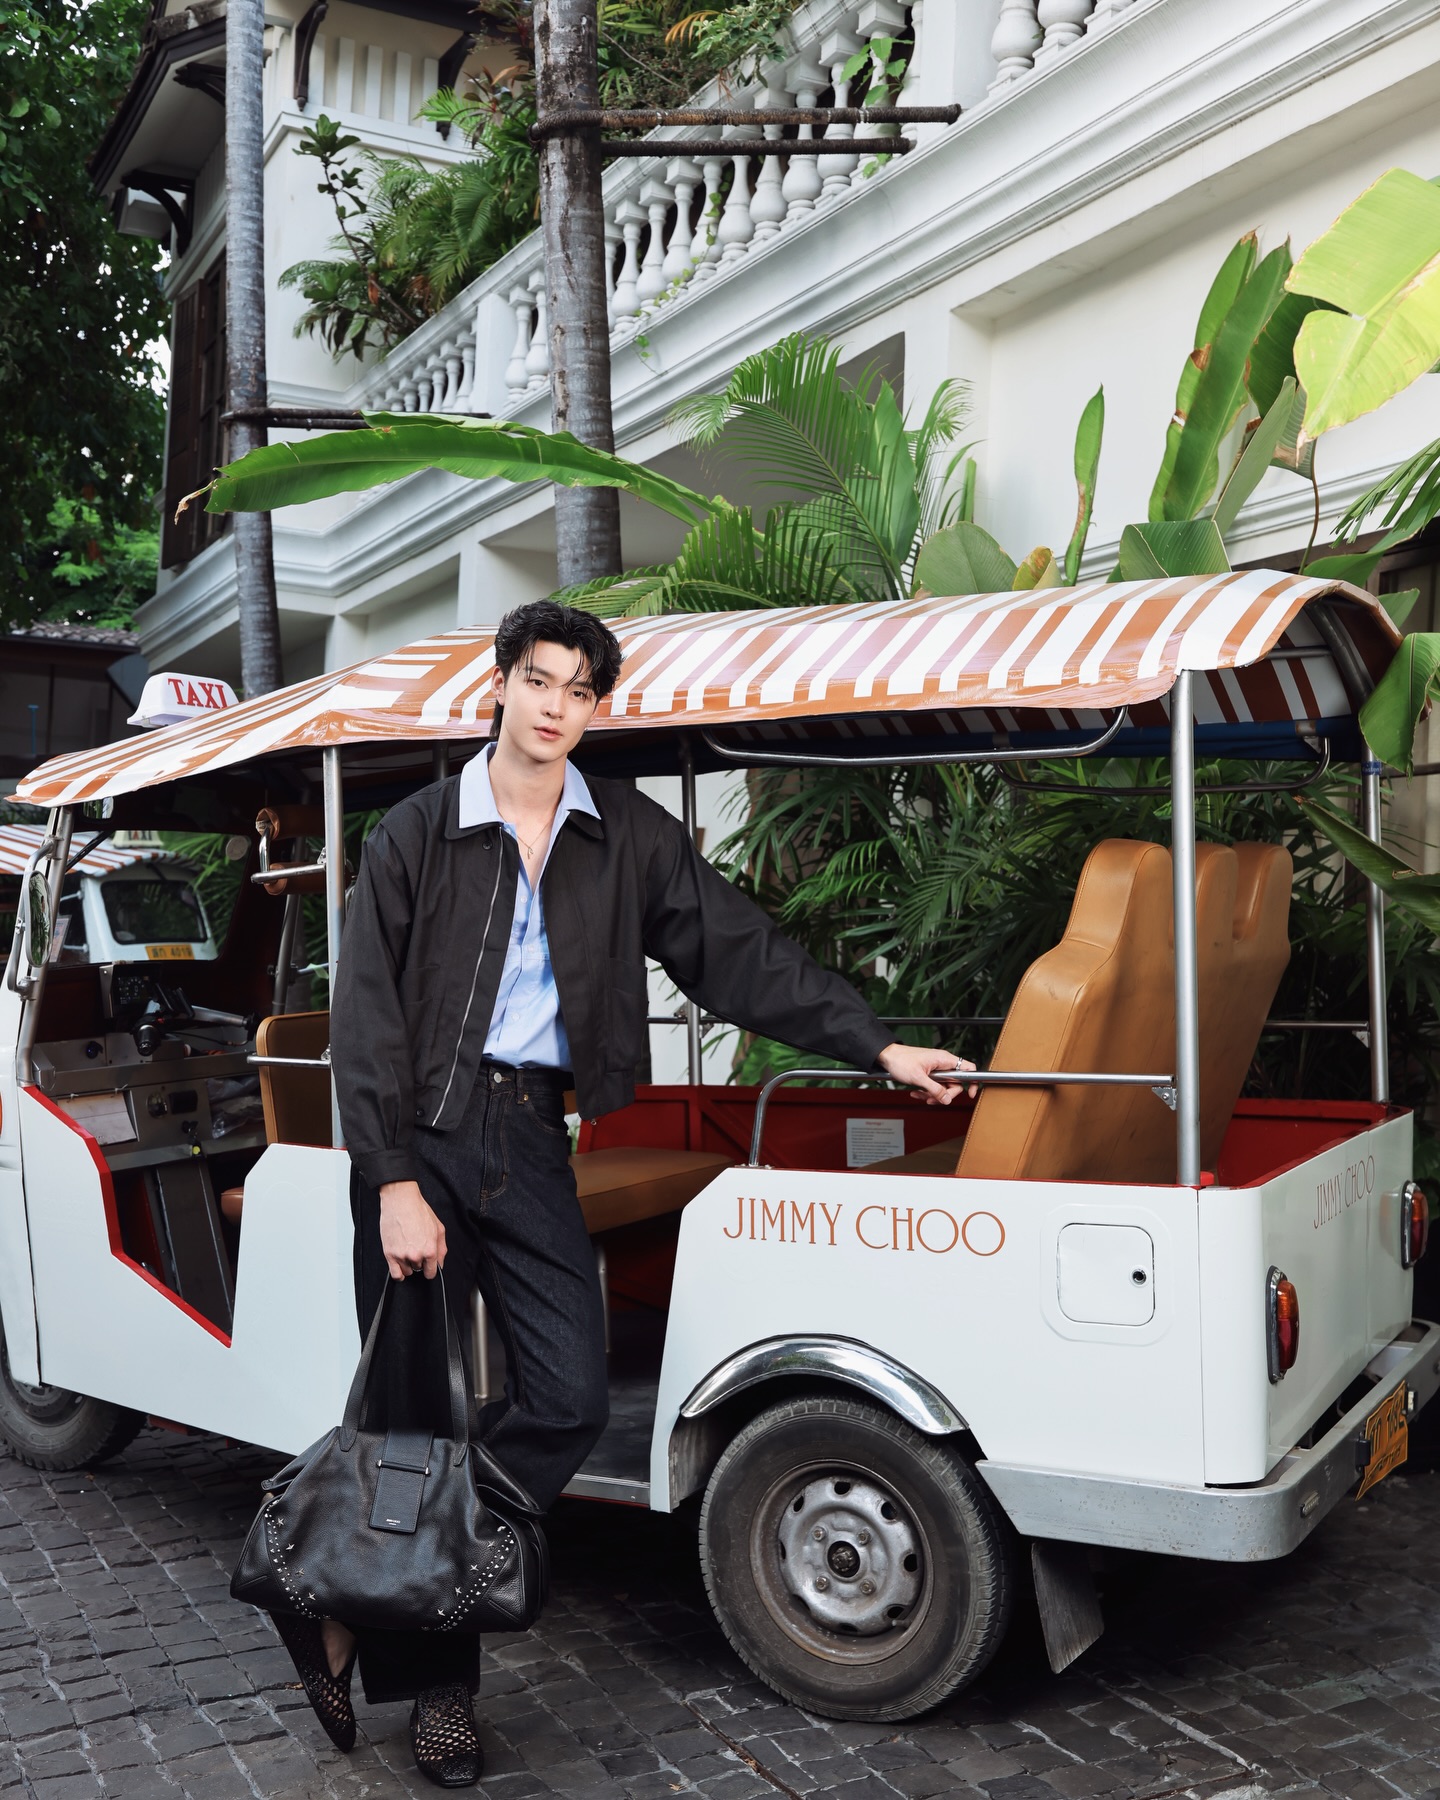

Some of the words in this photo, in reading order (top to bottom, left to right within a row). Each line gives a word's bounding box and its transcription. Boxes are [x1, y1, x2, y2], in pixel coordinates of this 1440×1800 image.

[168, 678, 228, 709] TAXI
[1313, 1172, 1343, 1230] JIMMY
[1344, 1154, 1376, 1208] CHOO
[723, 1197, 843, 1246] JIMMY
[855, 1205, 1006, 1257] CHOO
